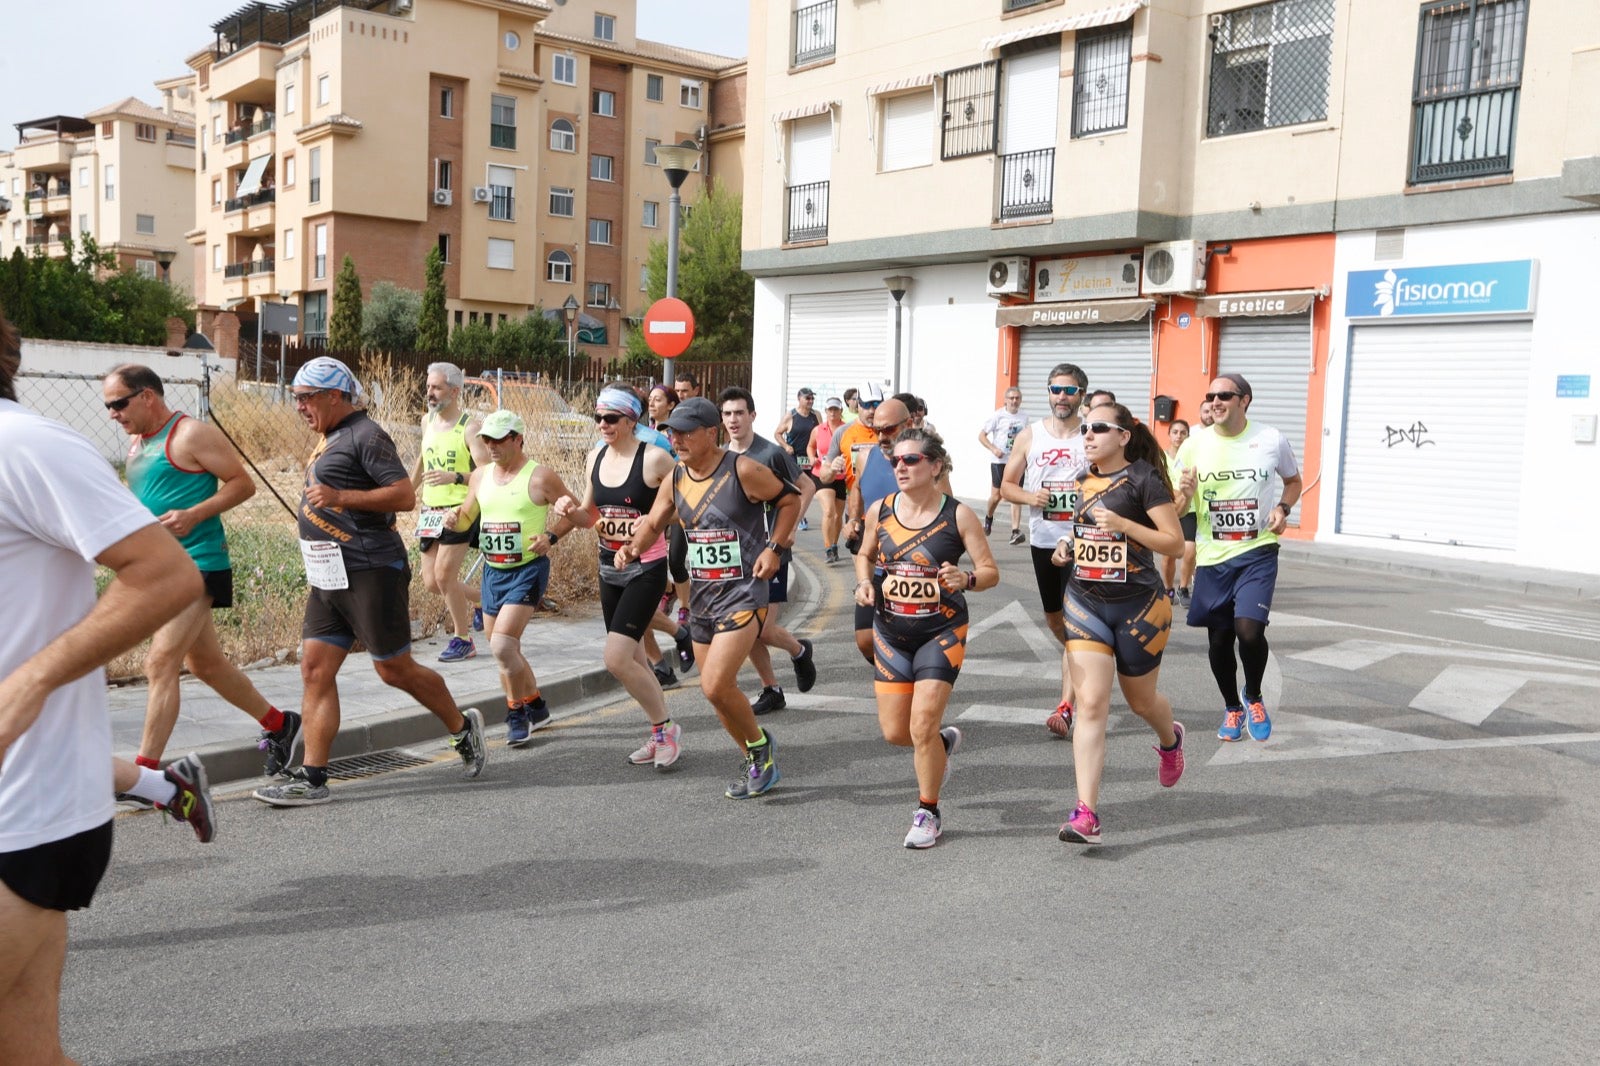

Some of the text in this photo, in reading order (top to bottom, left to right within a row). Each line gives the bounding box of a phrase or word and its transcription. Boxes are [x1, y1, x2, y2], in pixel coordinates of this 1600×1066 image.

[1395, 278, 1498, 307] fisiomar
[1259, 467, 1269, 481] 4
[424, 516, 442, 528] 188
[1215, 512, 1256, 527] 3063
[485, 535, 515, 551] 315
[696, 545, 731, 565] 135
[1077, 543, 1122, 563] 2056
[889, 579, 935, 598] 2020
